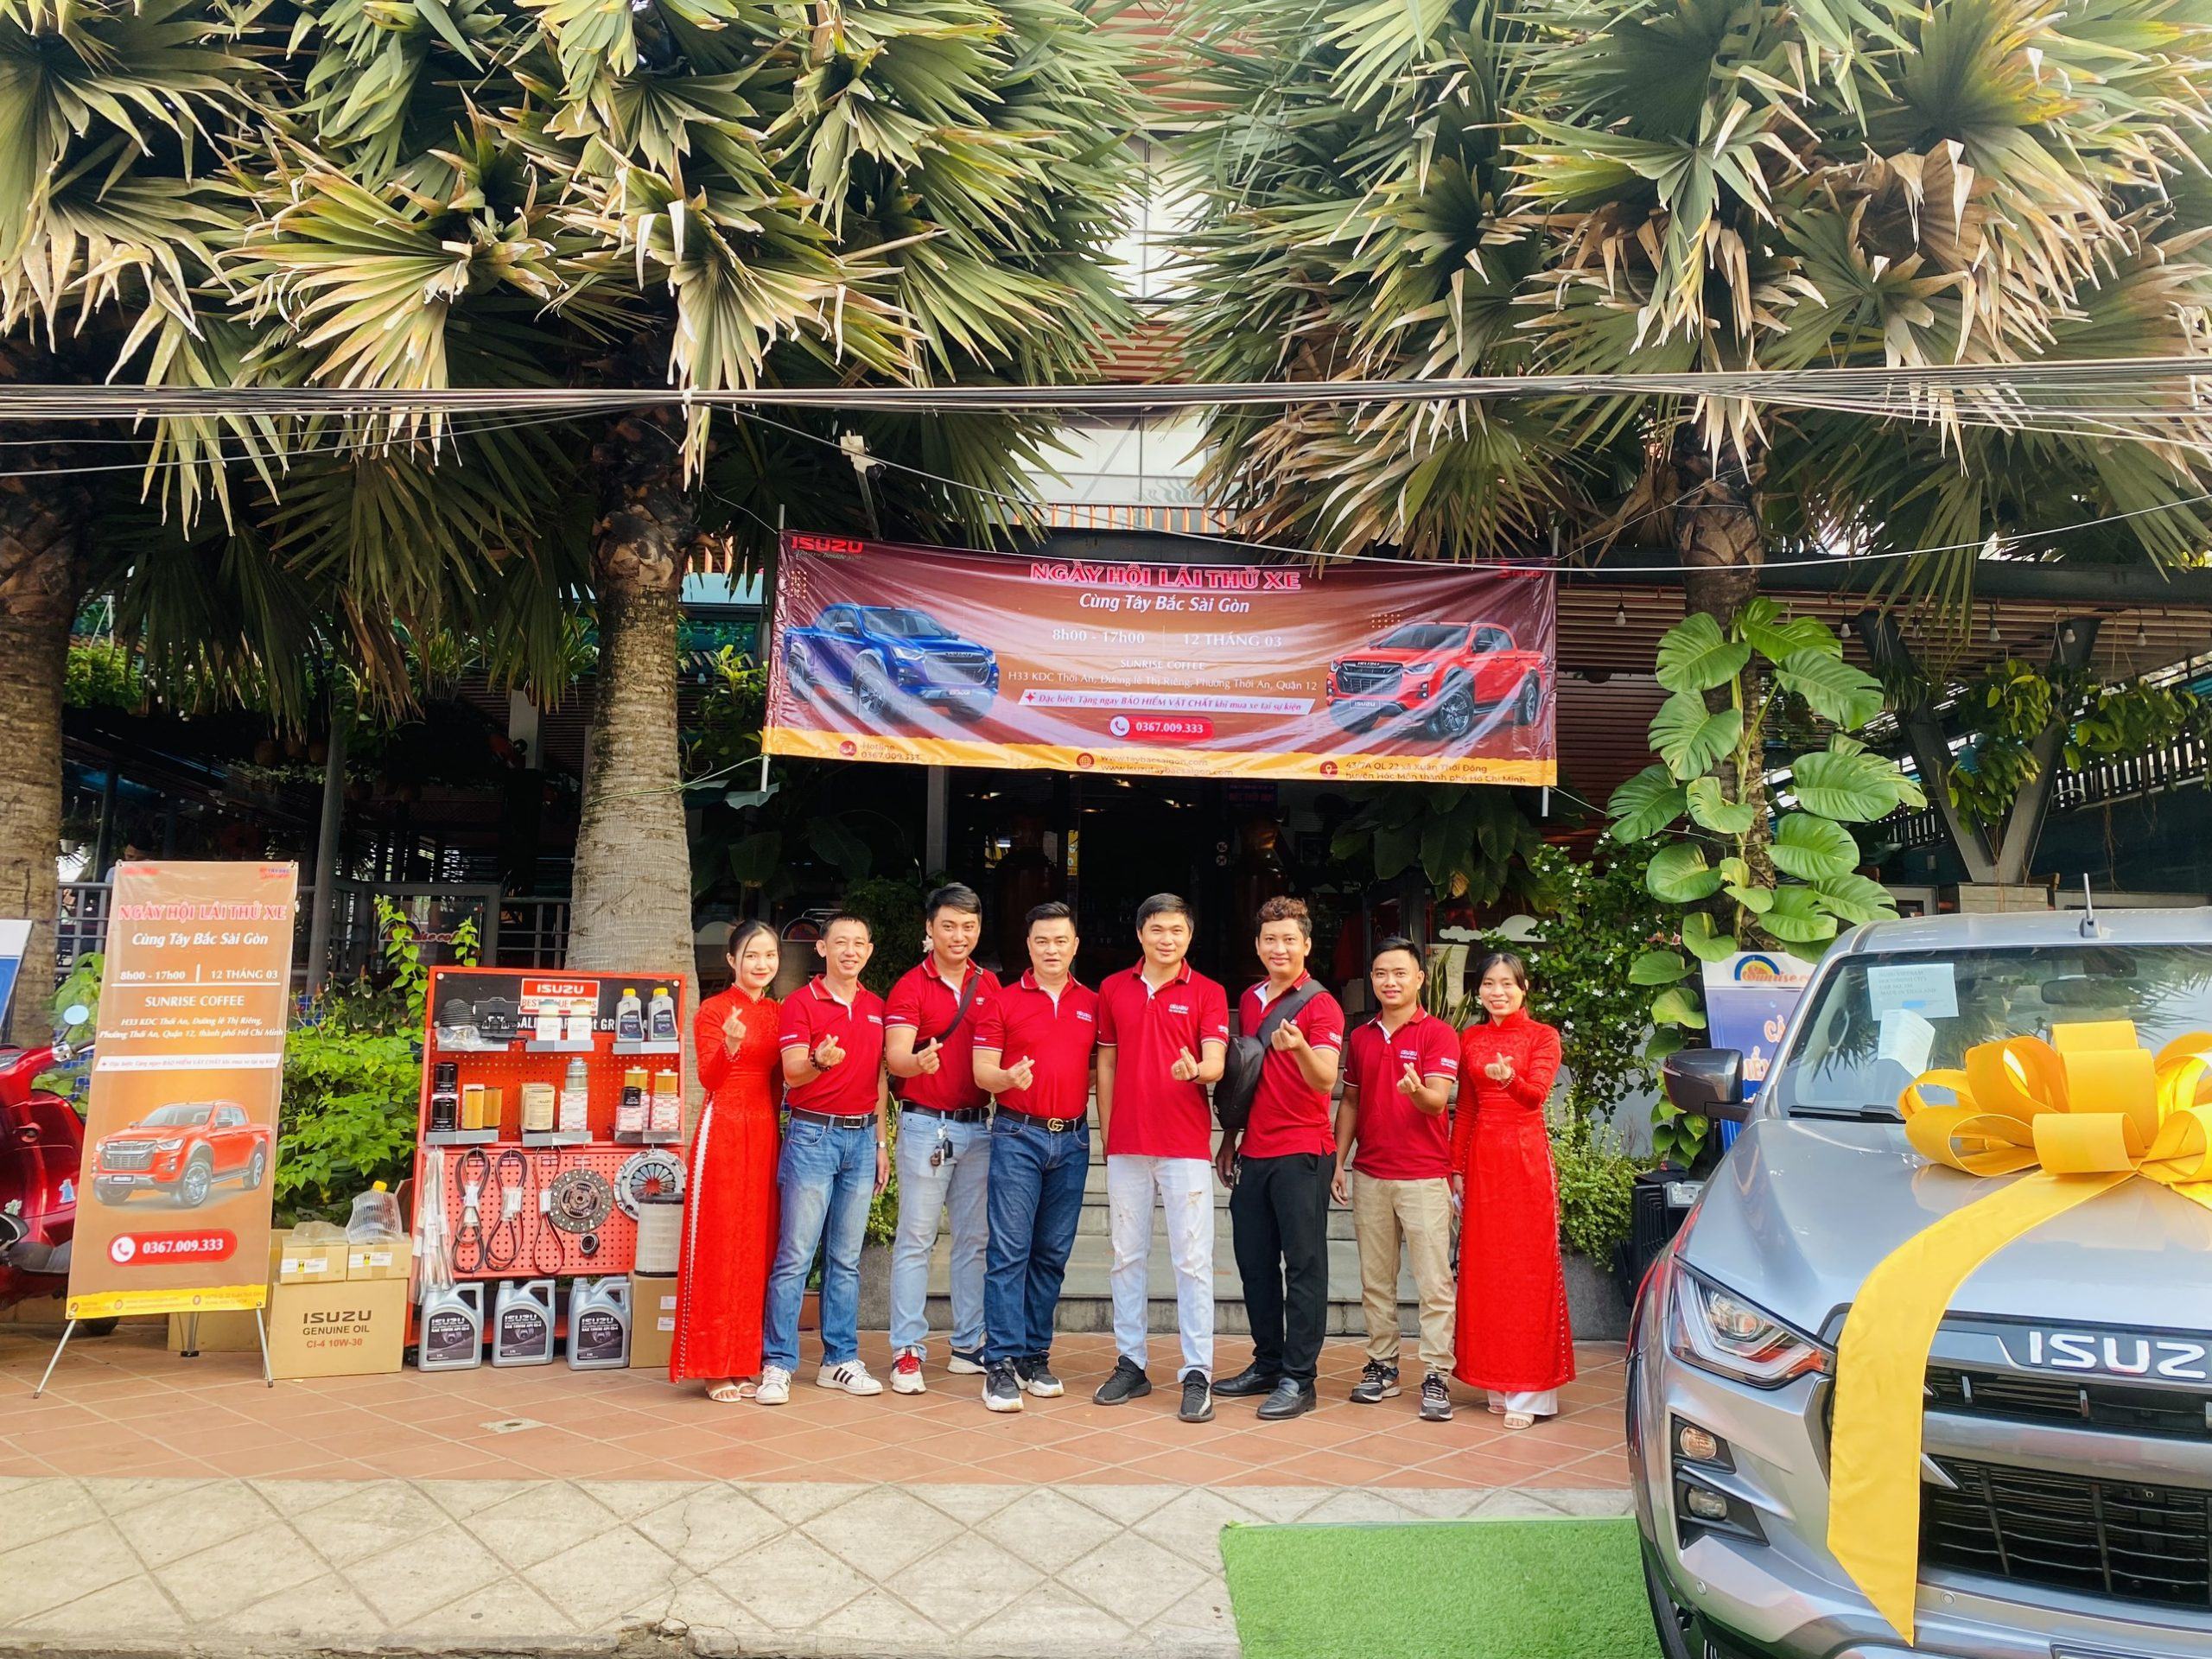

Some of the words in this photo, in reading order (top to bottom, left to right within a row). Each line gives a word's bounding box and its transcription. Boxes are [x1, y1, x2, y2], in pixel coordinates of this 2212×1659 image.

[792, 536, 863, 553] ISUZU
[1030, 560, 1104, 583] NGÀY
[1106, 563, 1152, 589] HỘI
[1158, 563, 1203, 588] LÁI
[1205, 566, 1261, 589] THỬ
[1262, 571, 1302, 589] XE
[1079, 593, 1120, 612] Cùng
[1125, 594, 1151, 613] Tây
[1154, 594, 1185, 611] Bắc
[1189, 596, 1214, 613] Sài
[1218, 597, 1250, 613] Gòn
[1052, 628, 1087, 641] 8h00
[1103, 631, 1145, 644] 17h00
[1185, 633, 1199, 645] 12
[1205, 631, 1260, 647] THÁNG
[1265, 635, 1282, 647] 03
[1120, 659, 1163, 670] SUNRISE
[1166, 661, 1206, 671] COFFEE
[1008, 672, 1029, 681] H33
[1032, 672, 1054, 682] KDC
[1275, 680, 1302, 690] Quận
[1306, 681, 1318, 690] 12
[1135, 721, 1204, 734] 0367.009.333
[118, 899, 166, 921] NGÀY
[166, 900, 195, 924] HỘI
[199, 900, 226, 920] LÁI
[227, 900, 263, 920] THỬ
[263, 904, 287, 920] XE
[132, 932, 165, 948] Cùng
[169, 932, 190, 947] Tây
[193, 931, 216, 945] Bắc
[219, 931, 240, 945] Sài
[243, 931, 269, 945] Gòn
[120, 971, 144, 981] 8h00
[155, 970, 186, 981] 17h00
[211, 970, 222, 979] 12
[226, 967, 263, 980] THÁNG
[265, 969, 278, 979] 03
[537, 983, 585, 995] ISUZU
[144, 995, 196, 1007] SUNRISE
[200, 995, 245, 1007] COFFEE
[143, 1238, 224, 1254] 0367.009.333
[303, 1310, 372, 1324] ISUZU
[431, 1317, 465, 1326] ISUZU
[504, 1313, 537, 1322] ISUZU
[582, 1317, 614, 1325] ISUZU
[302, 1325, 350, 1336] GENUINE
[353, 1325, 370, 1333] OIL
[329, 1338, 363, 1348] 10W-30
[2029, 1331, 2212, 1379] ISUZ
